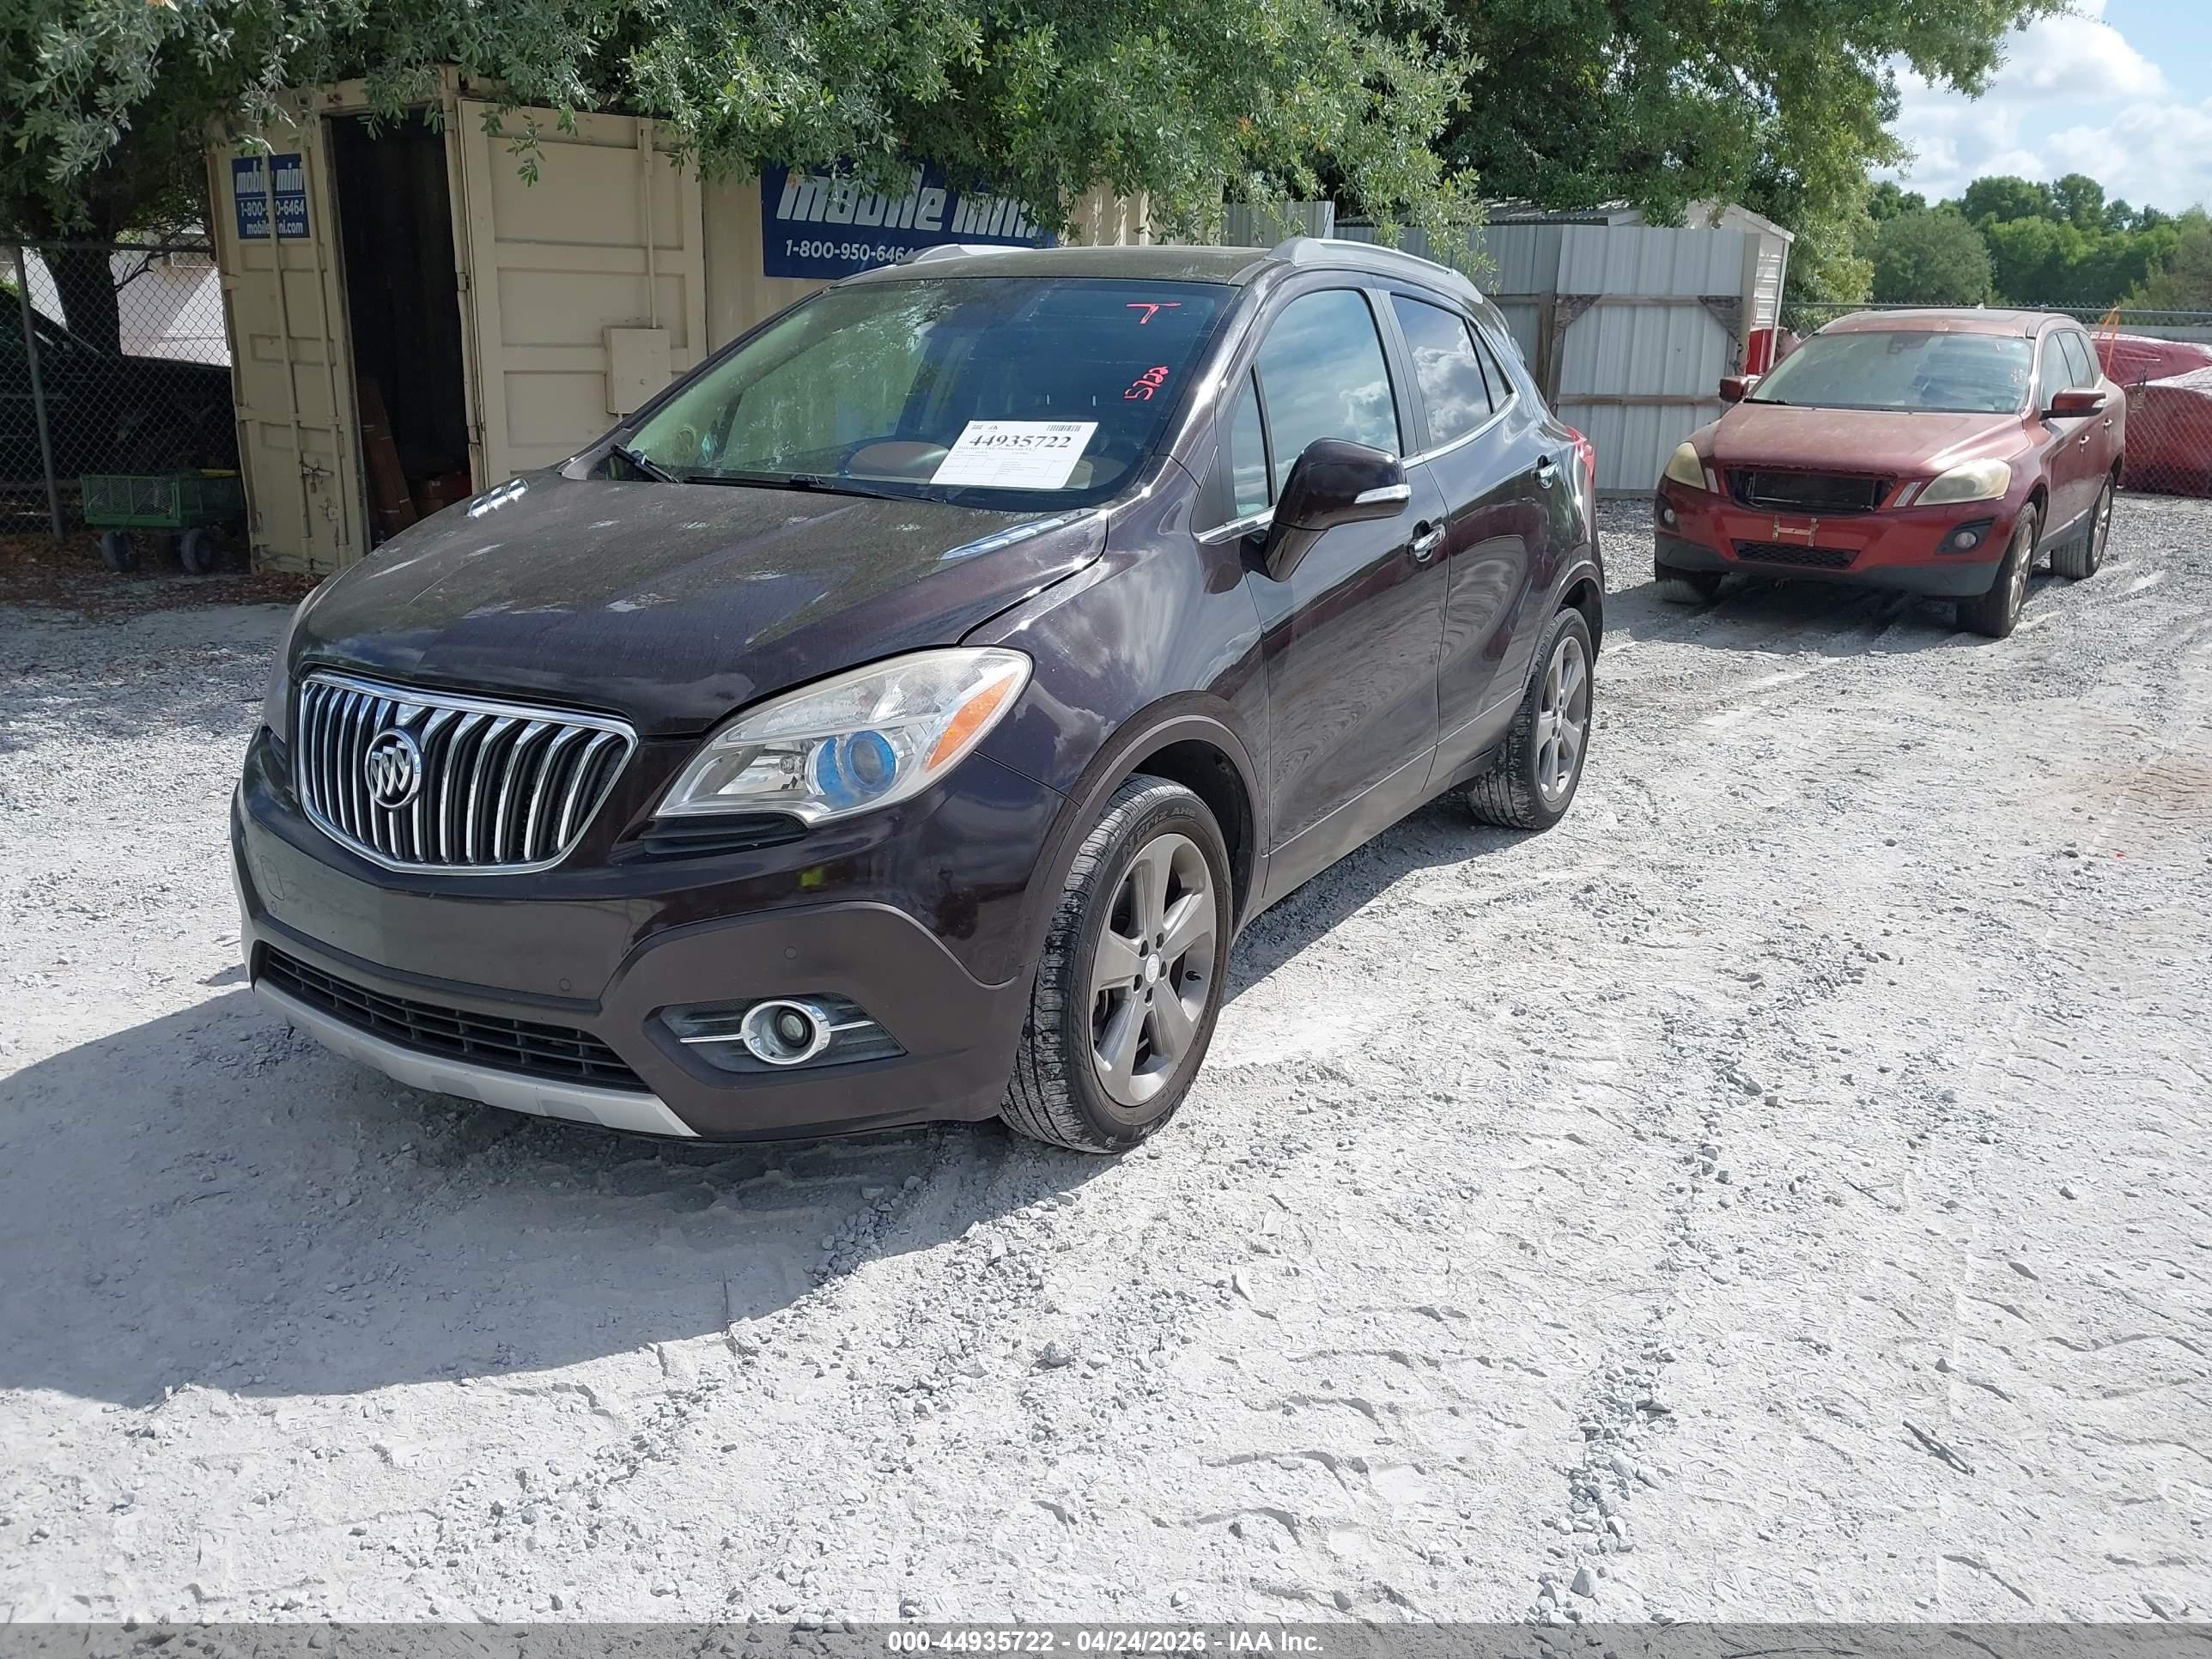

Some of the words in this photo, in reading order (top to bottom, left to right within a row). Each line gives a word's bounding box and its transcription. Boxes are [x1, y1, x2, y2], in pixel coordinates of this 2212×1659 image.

[236, 160, 274, 193] mobi
[240, 198, 305, 217] 1-800-0-6464
[246, 219, 303, 235] mobileini.com
[969, 434, 1072, 448] 44935722
